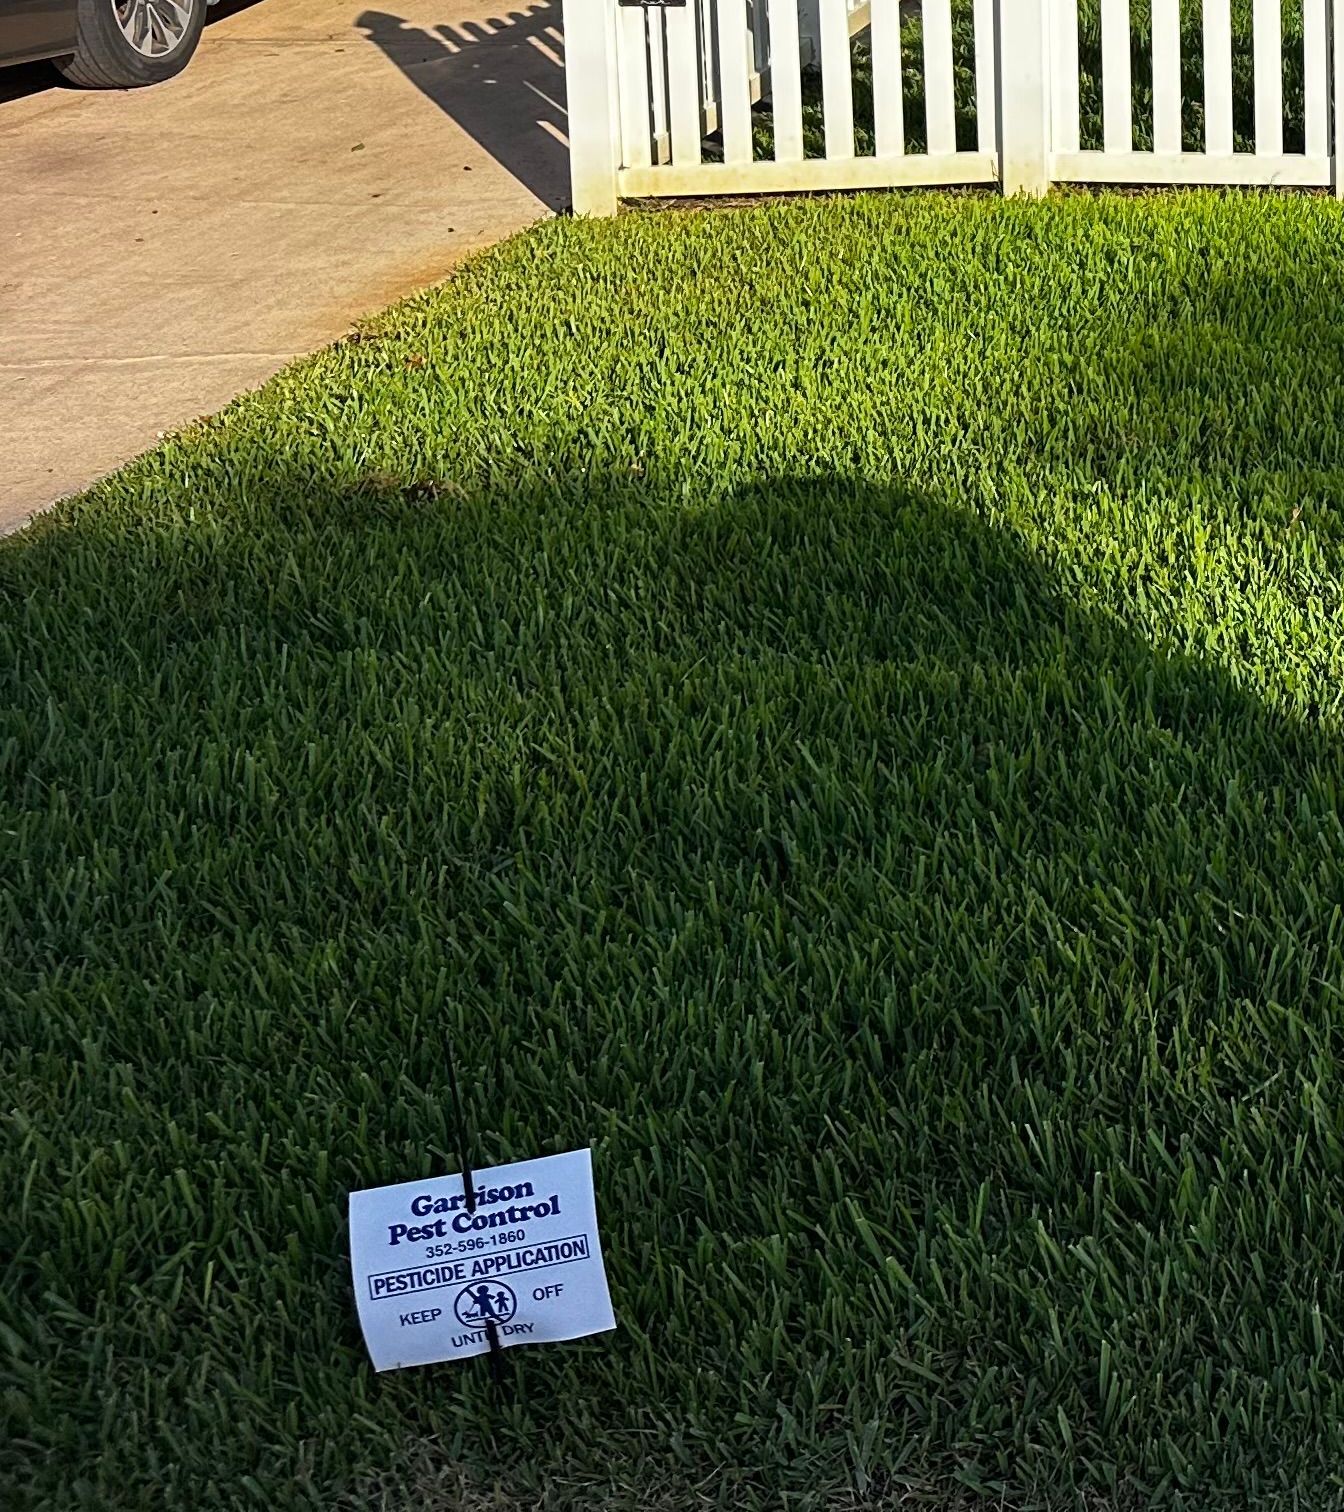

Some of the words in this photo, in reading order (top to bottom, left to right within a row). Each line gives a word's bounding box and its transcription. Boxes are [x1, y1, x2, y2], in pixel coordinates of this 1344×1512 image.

[388, 1218, 447, 1245] Pest
[451, 1195, 561, 1233] Control
[426, 1229, 525, 1258] 352-596-1860
[374, 1263, 466, 1295] PESTICIDE
[471, 1240, 586, 1277] APPLICATION
[400, 1308, 442, 1326] KEEP
[532, 1284, 564, 1301] OFF
[451, 1329, 499, 1347] UNTI
[502, 1323, 535, 1336] DRY
